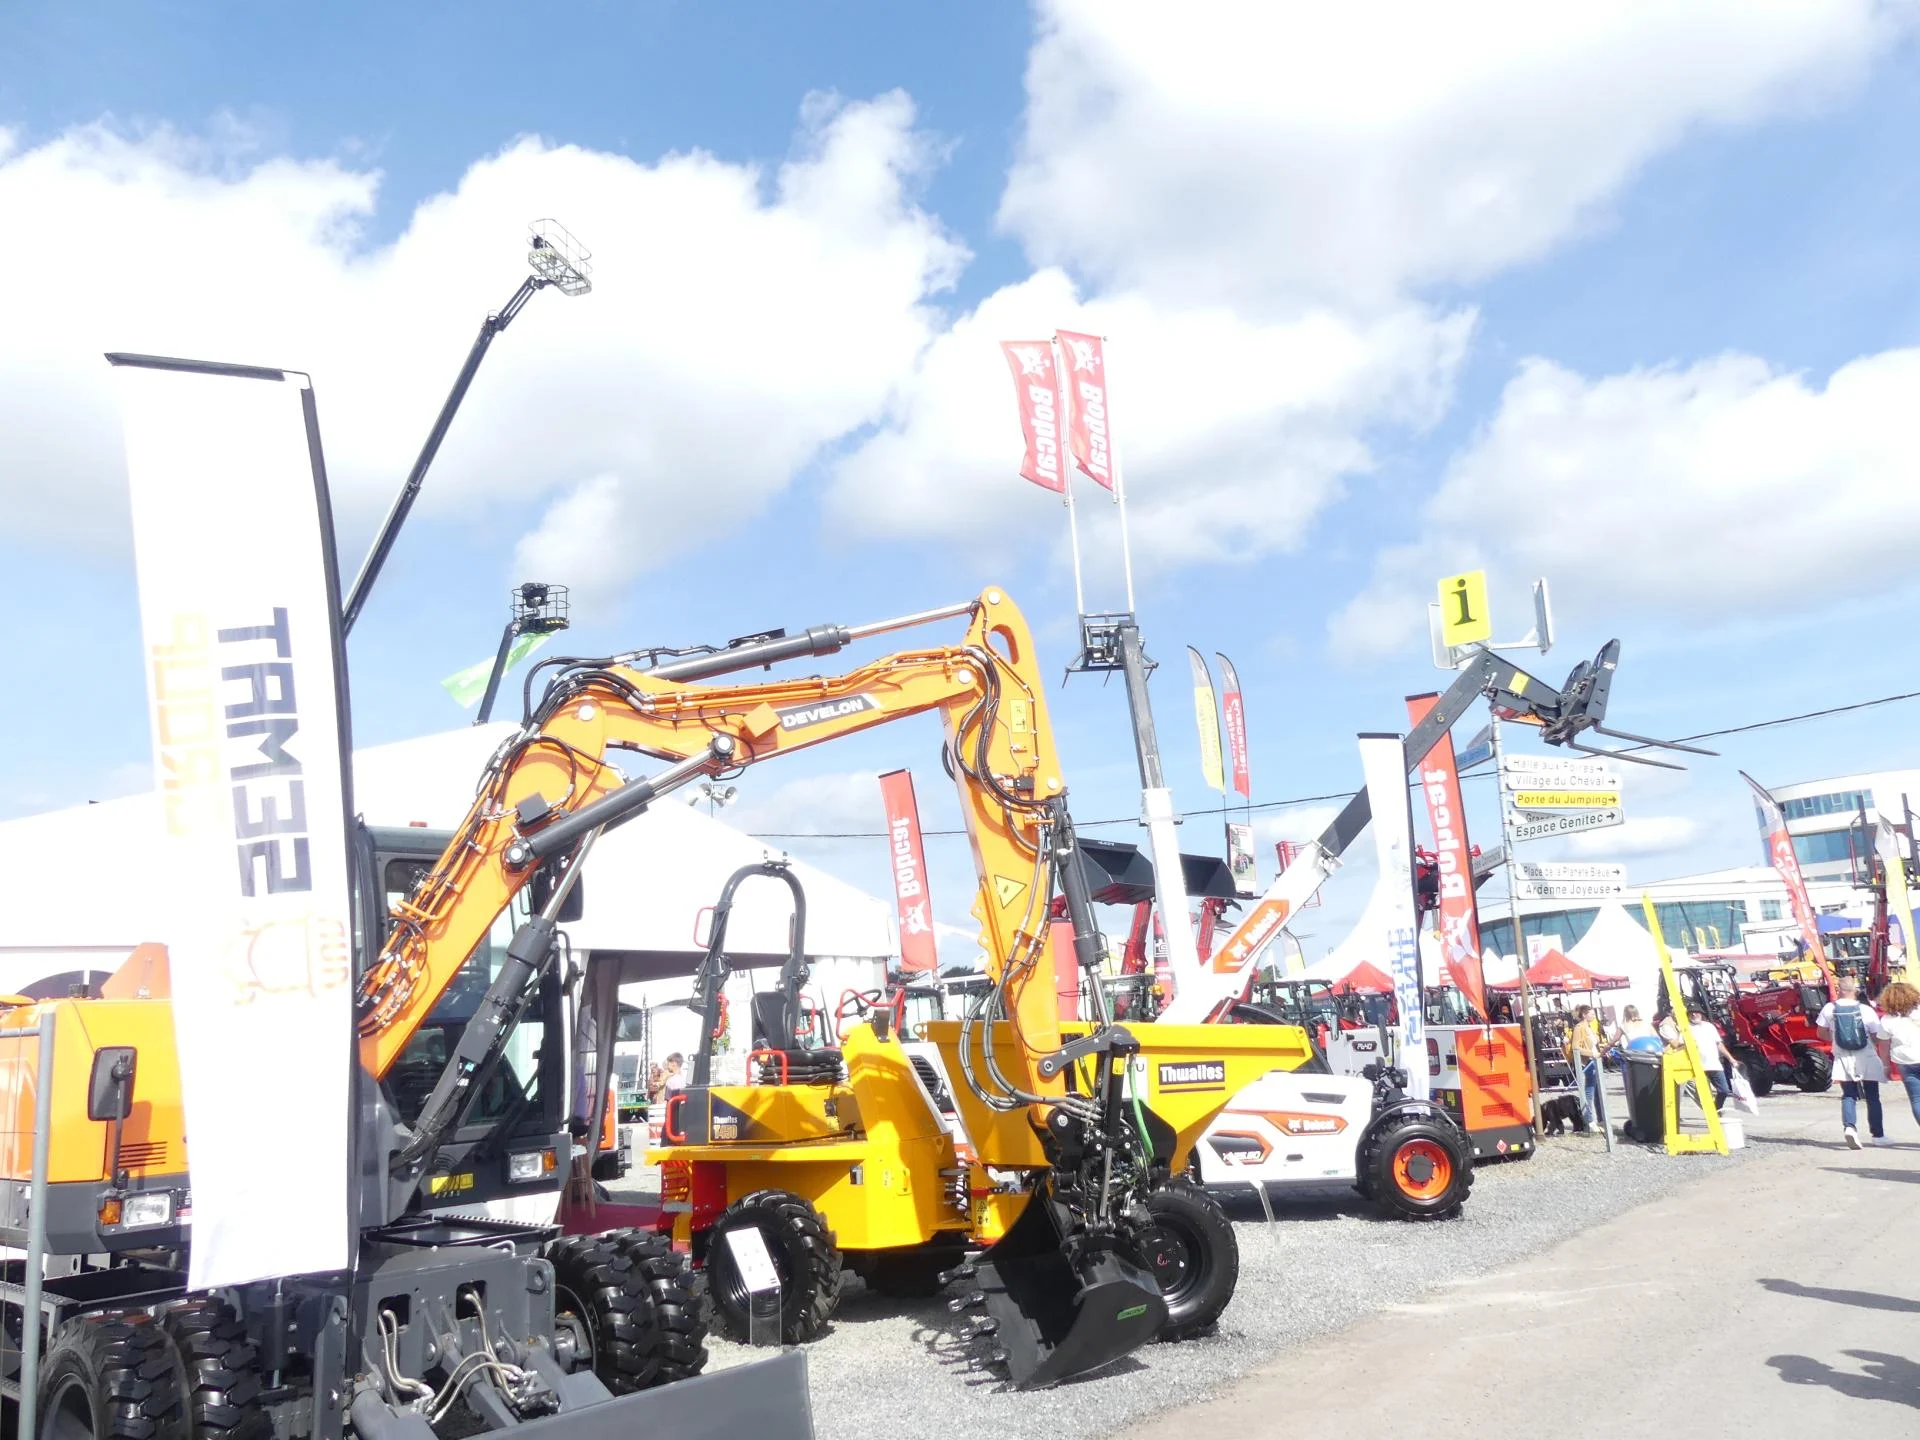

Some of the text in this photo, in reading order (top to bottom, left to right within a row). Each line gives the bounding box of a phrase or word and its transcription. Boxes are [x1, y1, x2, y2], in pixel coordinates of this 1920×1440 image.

[782, 699, 864, 728] DEVELON
[1513, 760, 1539, 770] Halle
[1516, 775, 1605, 788] Village du Cheval
[1517, 794, 1608, 807] Porte du Jumping
[1516, 813, 1604, 837] Espace Genitec
[1524, 866, 1543, 877] Place
[1526, 884, 1611, 897] Ardenne Joyeuse
[1243, 908, 1282, 946] Bobcat
[1159, 1064, 1224, 1083] Thwaites
[1303, 1119, 1336, 1131] Bobcat
